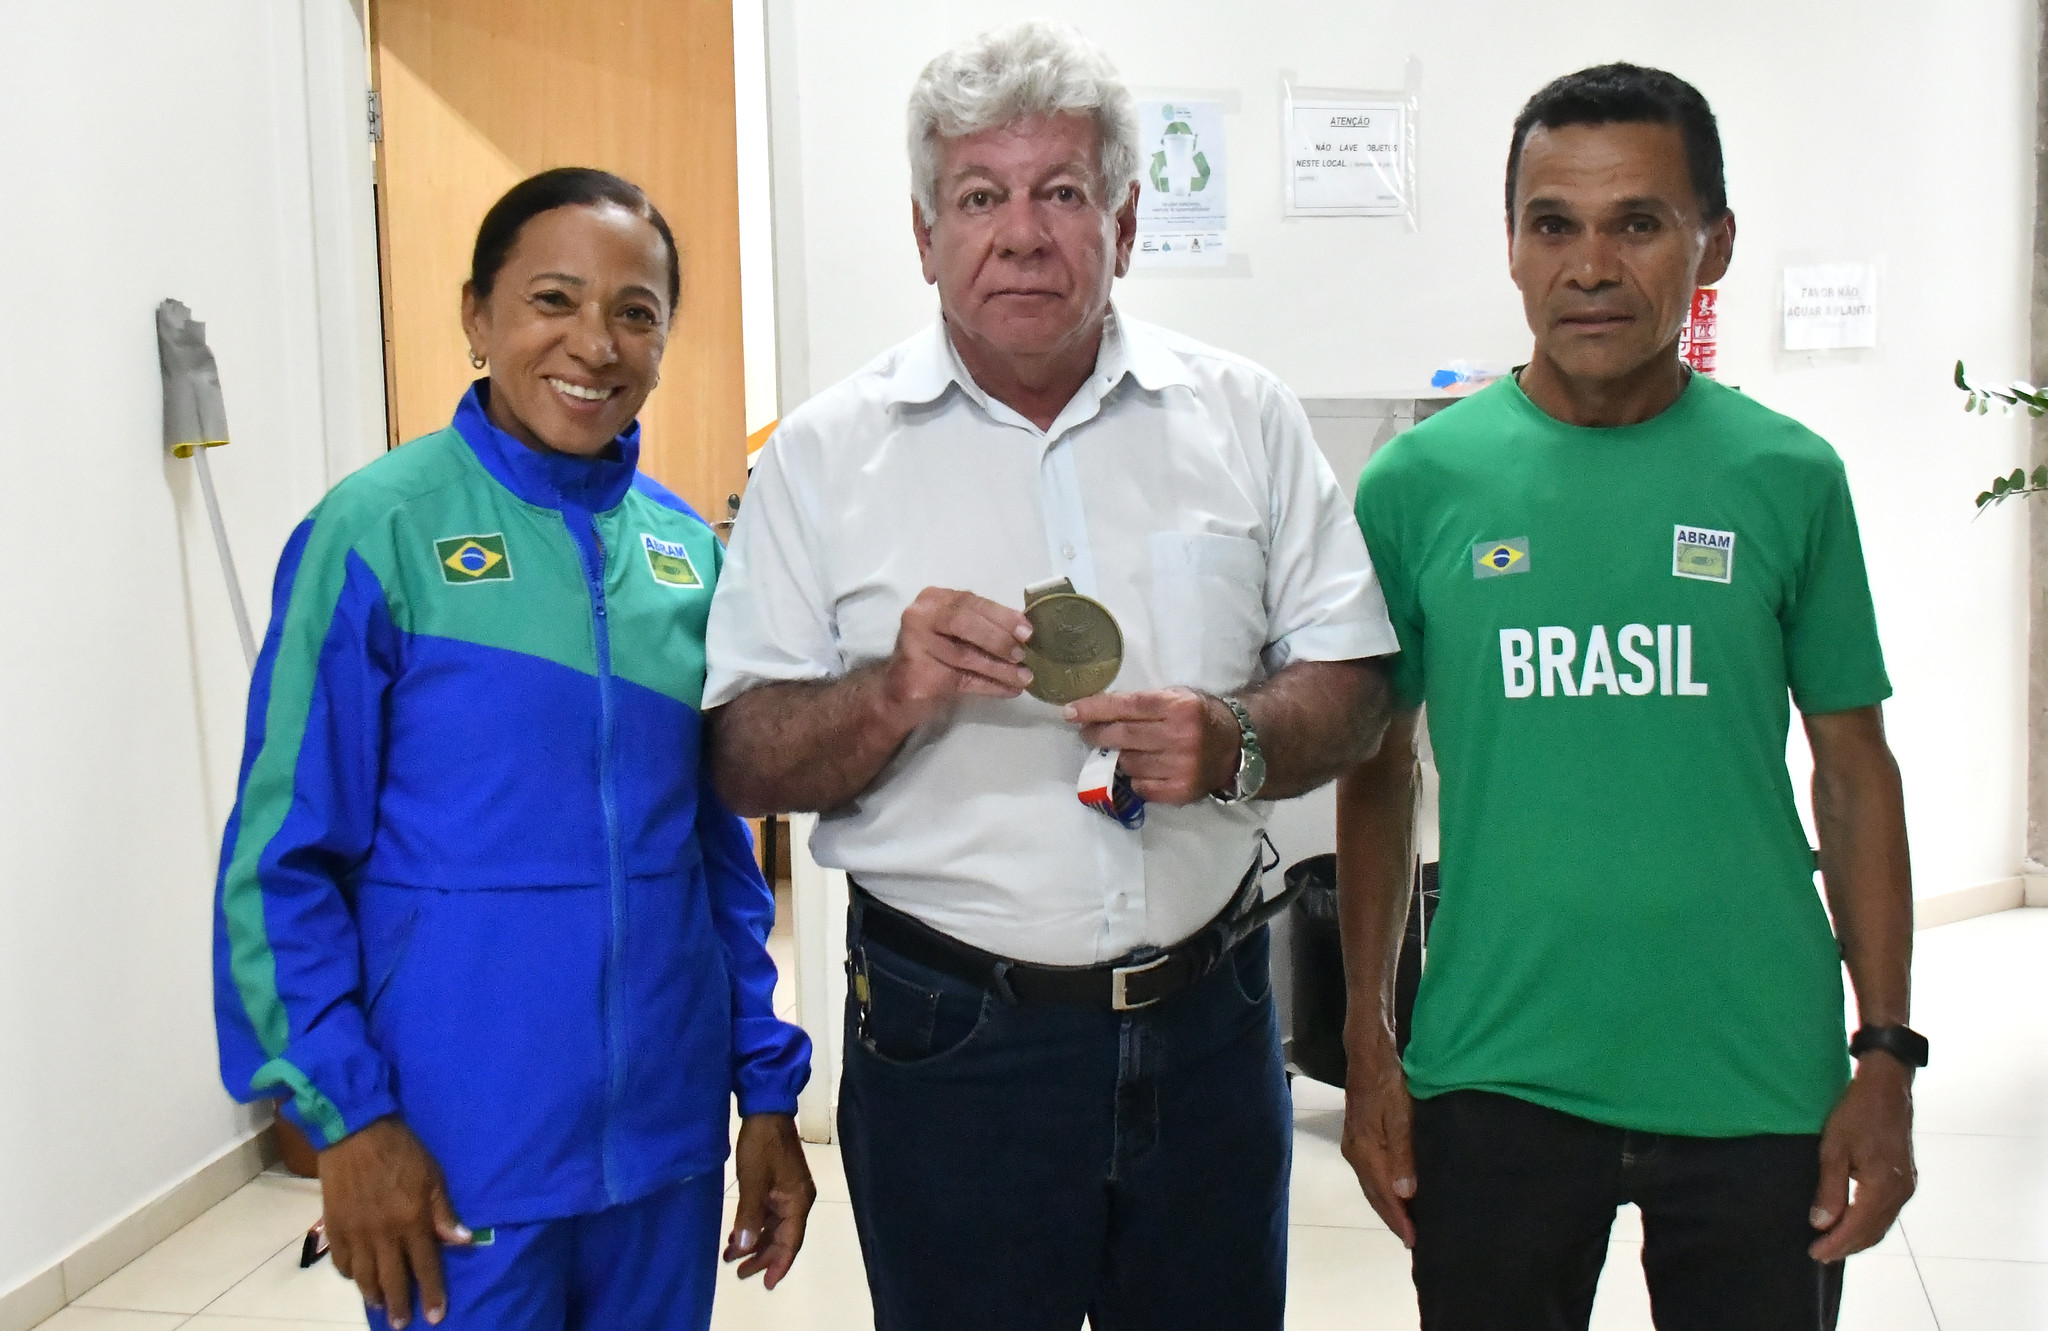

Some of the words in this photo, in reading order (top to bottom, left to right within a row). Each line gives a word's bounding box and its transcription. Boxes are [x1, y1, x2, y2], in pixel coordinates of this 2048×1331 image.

[1330, 116, 1370, 126] ATENÇÃO
[1315, 143, 1332, 152] NÃO
[1339, 144, 1358, 152] LAVE
[1801, 287, 1834, 298] FAVOR
[1837, 285, 1859, 297] NÃO
[1787, 306, 1821, 317] AGUAR
[1833, 305, 1872, 316] PLANTA
[1677, 530, 1730, 548] ABRAM
[645, 537, 686, 558] ABRAM
[1499, 623, 1708, 698] BRASIL
